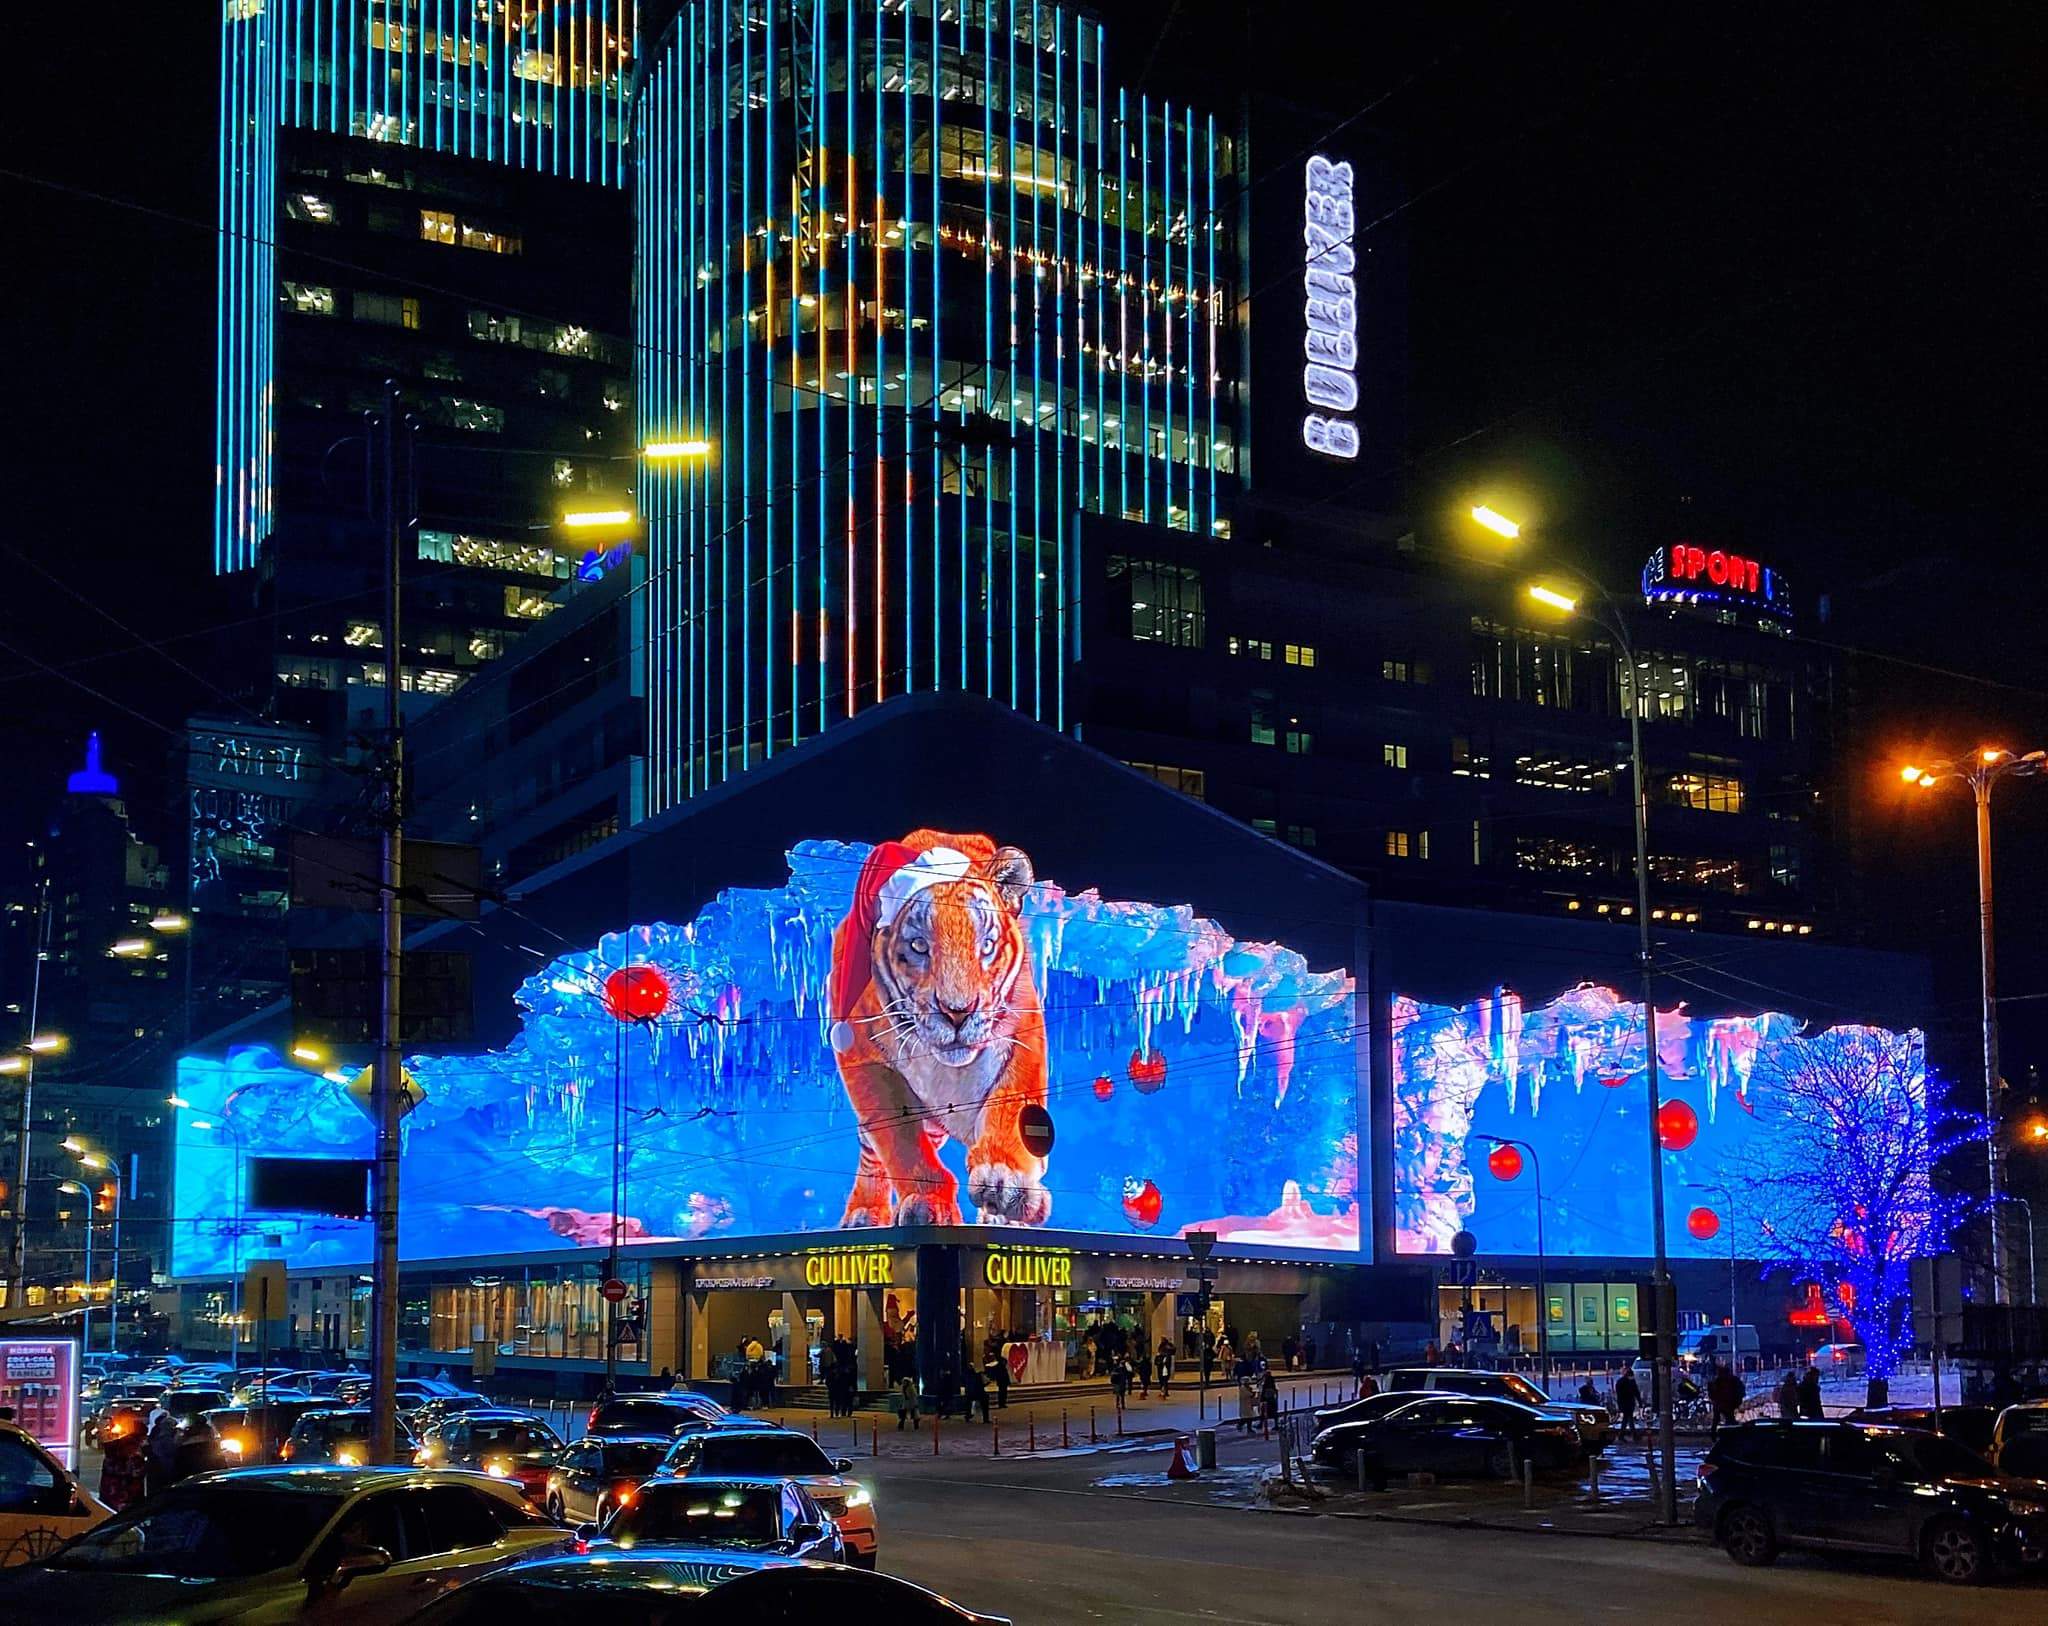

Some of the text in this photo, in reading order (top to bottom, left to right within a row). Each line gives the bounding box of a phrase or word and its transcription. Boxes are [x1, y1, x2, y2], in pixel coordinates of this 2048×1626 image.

[1672, 545, 1759, 592] SPORT
[806, 1254, 893, 1286] GULLIVER
[986, 1253, 1072, 1286] GULLIVER
